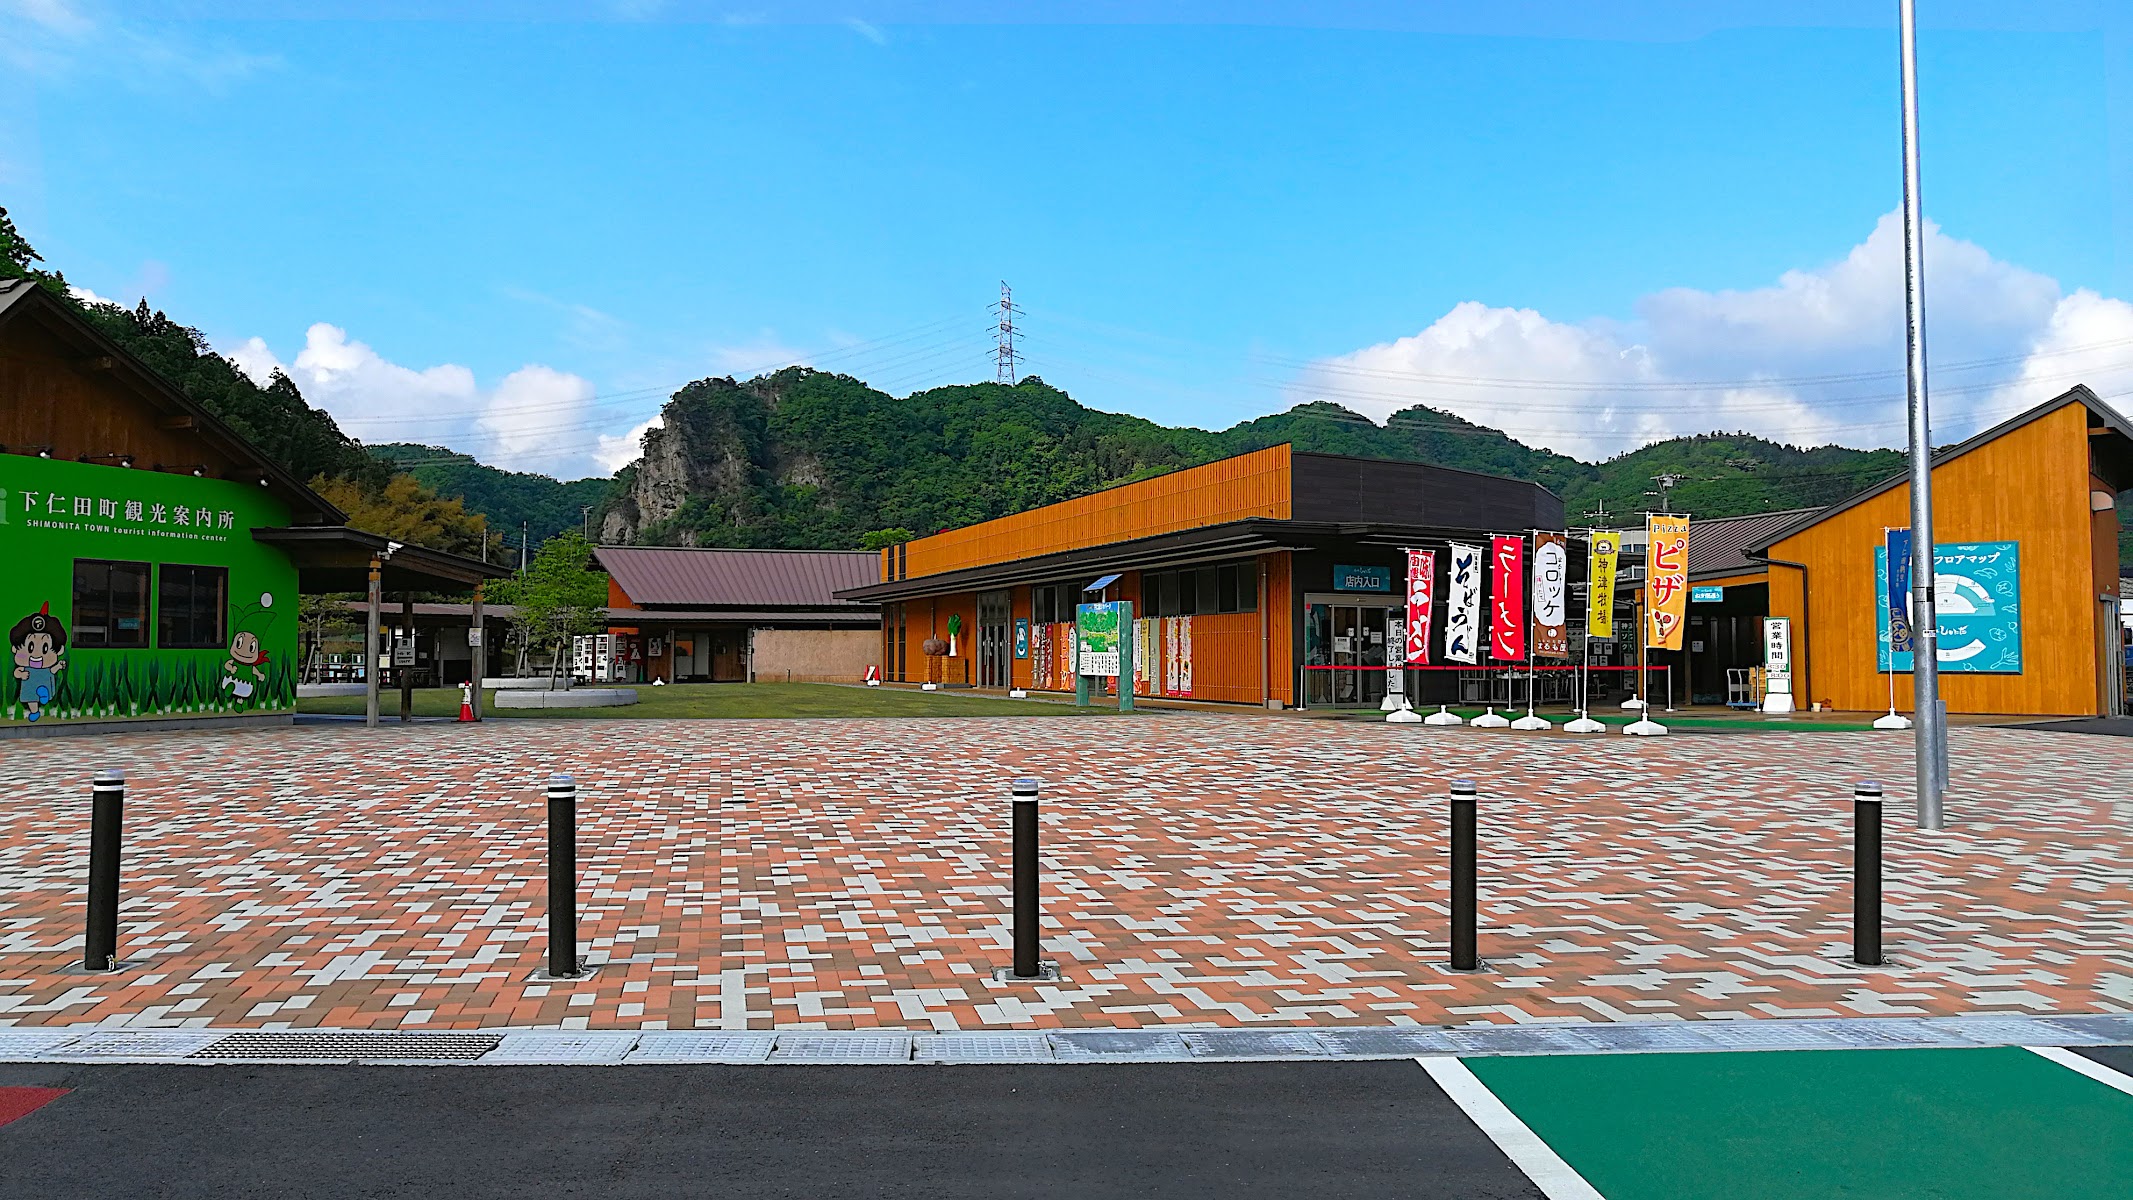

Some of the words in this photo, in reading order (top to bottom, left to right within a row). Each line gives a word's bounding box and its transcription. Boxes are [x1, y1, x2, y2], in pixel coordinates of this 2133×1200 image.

[18, 491, 235, 529] 下仁田町観光案内所
[26, 519, 80, 530] SHIMONITA
[84, 523, 110, 532] TOWN
[113, 527, 145, 535] tourist
[148, 530, 198, 539] information
[1653, 524, 1687, 533] Pizza
[1653, 538, 1686, 607] ピザ
[1932, 551, 2000, 566] フロアマップ
[1345, 575, 1380, 588] 店内入口
[1498, 545, 1517, 656] ラーメン
[1543, 552, 1560, 617] コロッケ
[1408, 580, 1429, 661] ラーメン
[1770, 622, 1783, 660] 営業時間
